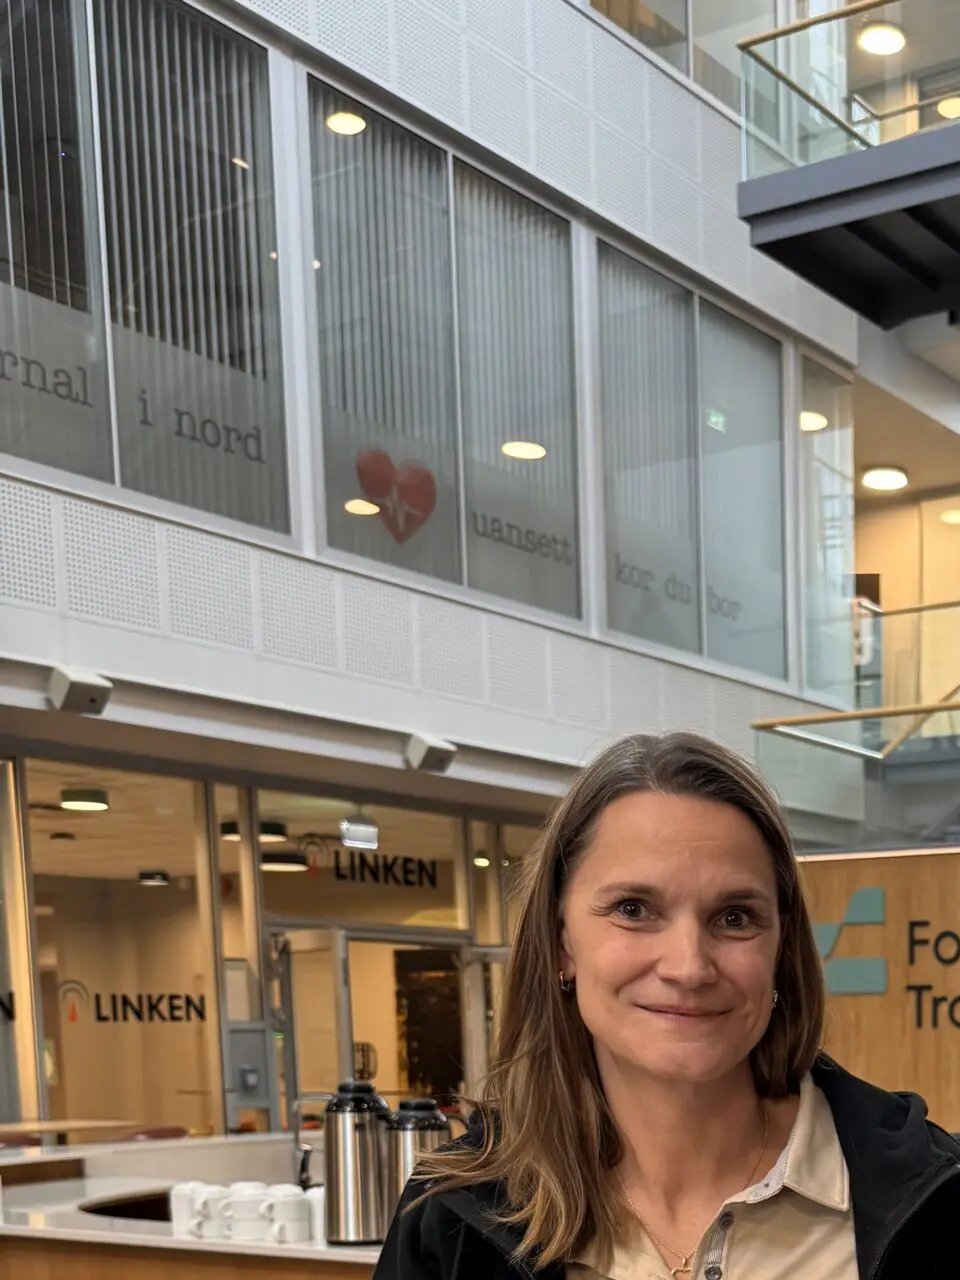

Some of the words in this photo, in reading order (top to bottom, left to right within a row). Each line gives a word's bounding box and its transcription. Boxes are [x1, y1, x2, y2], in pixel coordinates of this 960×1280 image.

[138, 389, 153, 427] i
[173, 407, 265, 464] nord
[472, 511, 574, 566] uansett
[614, 553, 656, 591] kor
[664, 571, 694, 606] du
[705, 584, 743, 621] bor
[334, 850, 438, 888] LINKEN
[94, 992, 206, 1023] LINKEN
